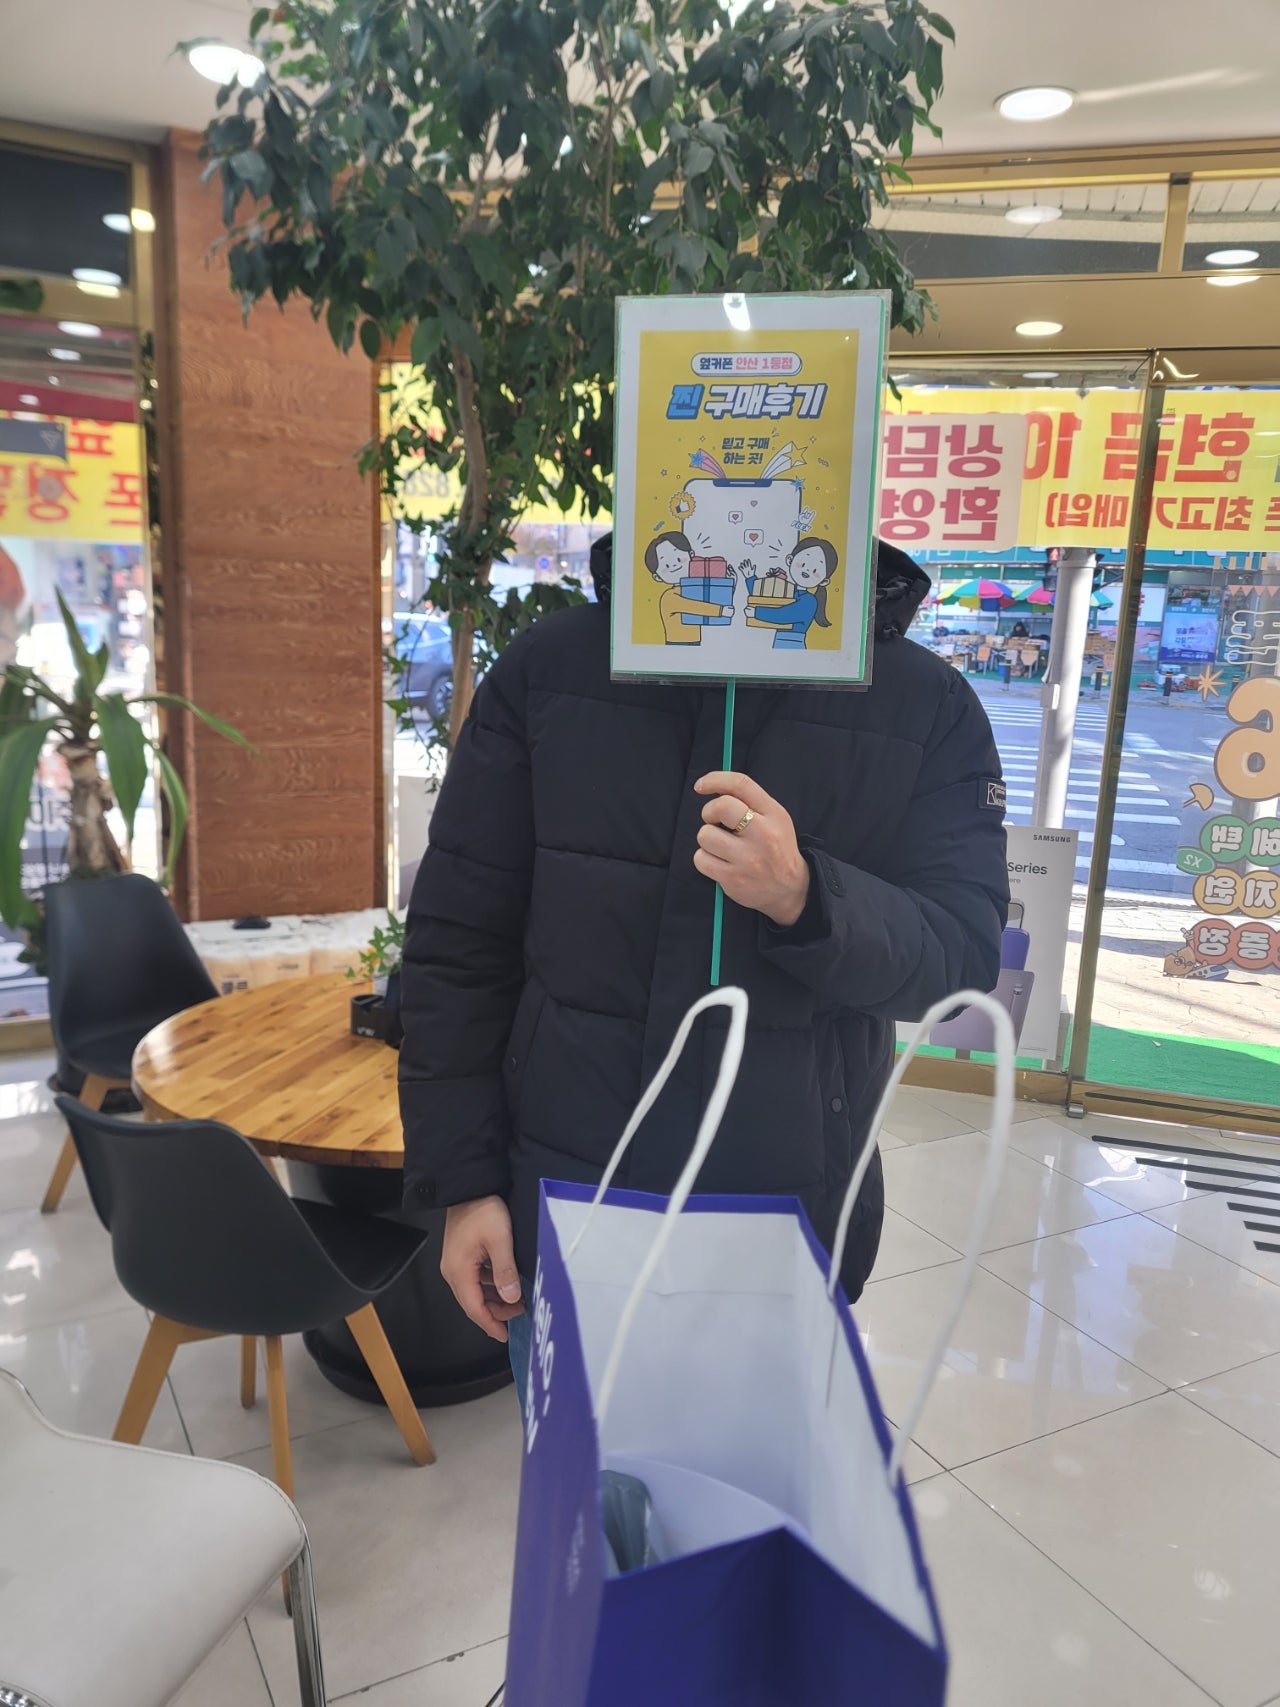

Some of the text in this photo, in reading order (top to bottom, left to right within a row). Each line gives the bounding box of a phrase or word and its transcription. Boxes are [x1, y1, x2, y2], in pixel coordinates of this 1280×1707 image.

[700, 356, 793, 370] 옆커폰 안산 1등점
[666, 382, 828, 419] 찐 구매후기
[721, 437, 770, 450] 믿고 구매
[723, 452, 763, 465] 하는 곳!
[1033, 834, 1071, 843] SAMSUNG
[1007, 862, 1048, 875] Series
